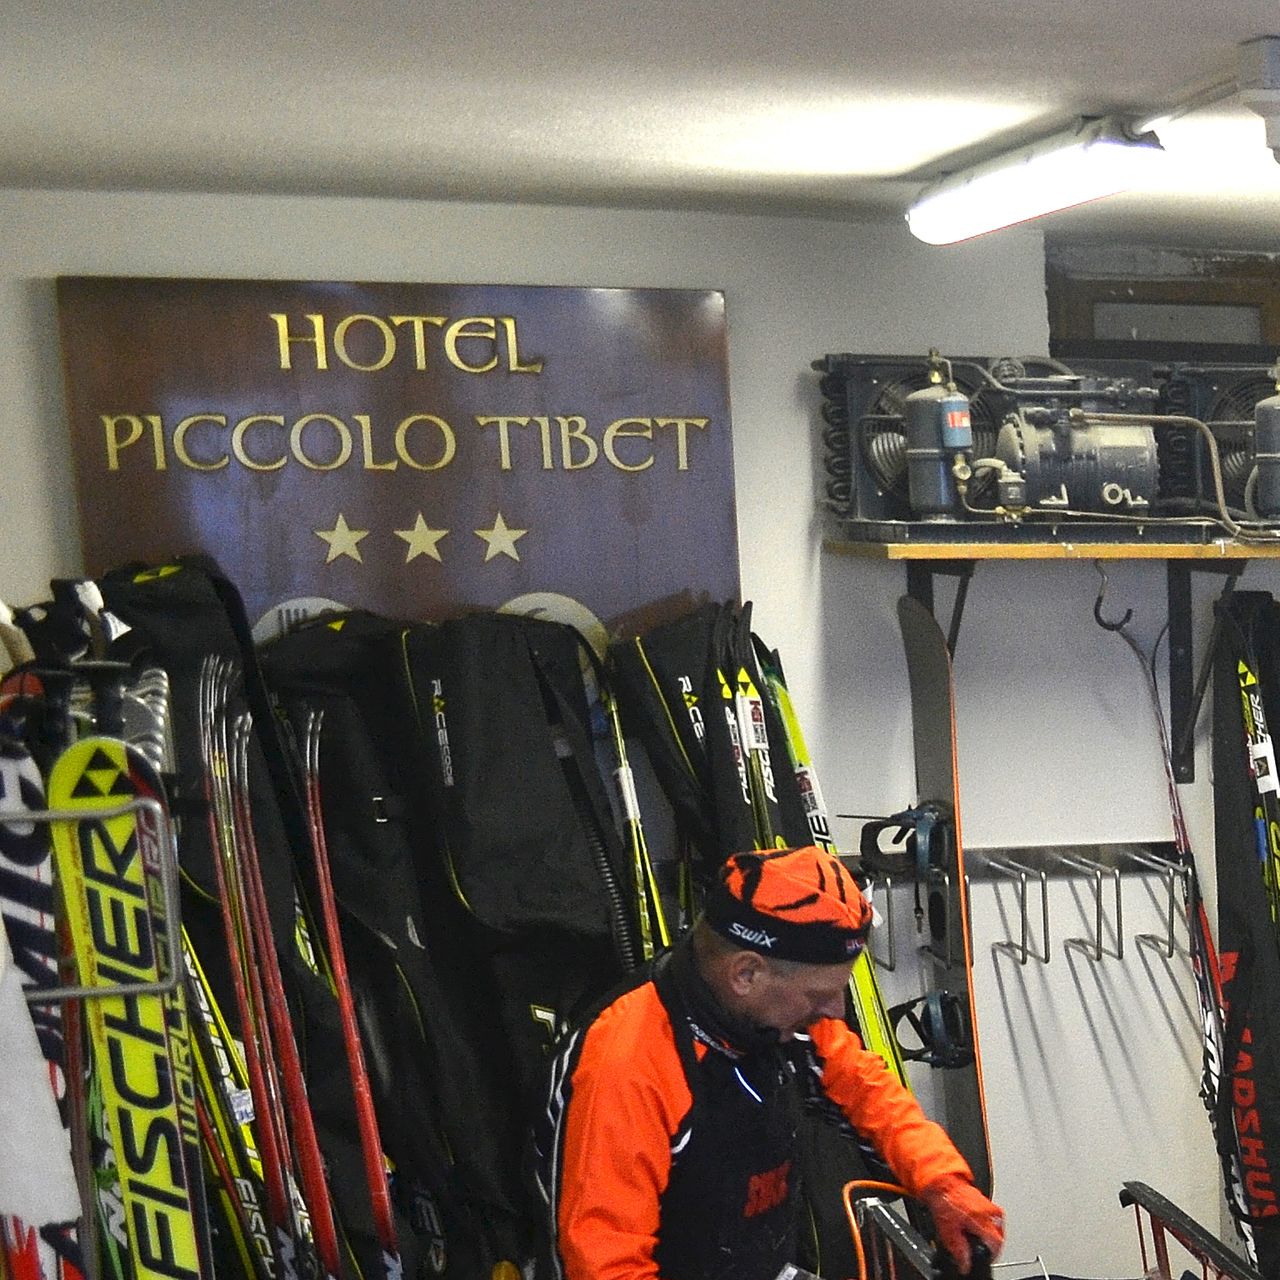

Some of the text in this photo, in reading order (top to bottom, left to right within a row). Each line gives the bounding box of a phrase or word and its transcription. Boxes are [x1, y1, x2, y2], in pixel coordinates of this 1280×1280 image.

[270, 312, 542, 374] HOTEL
[100, 413, 709, 472] PICCOLO TIBET
